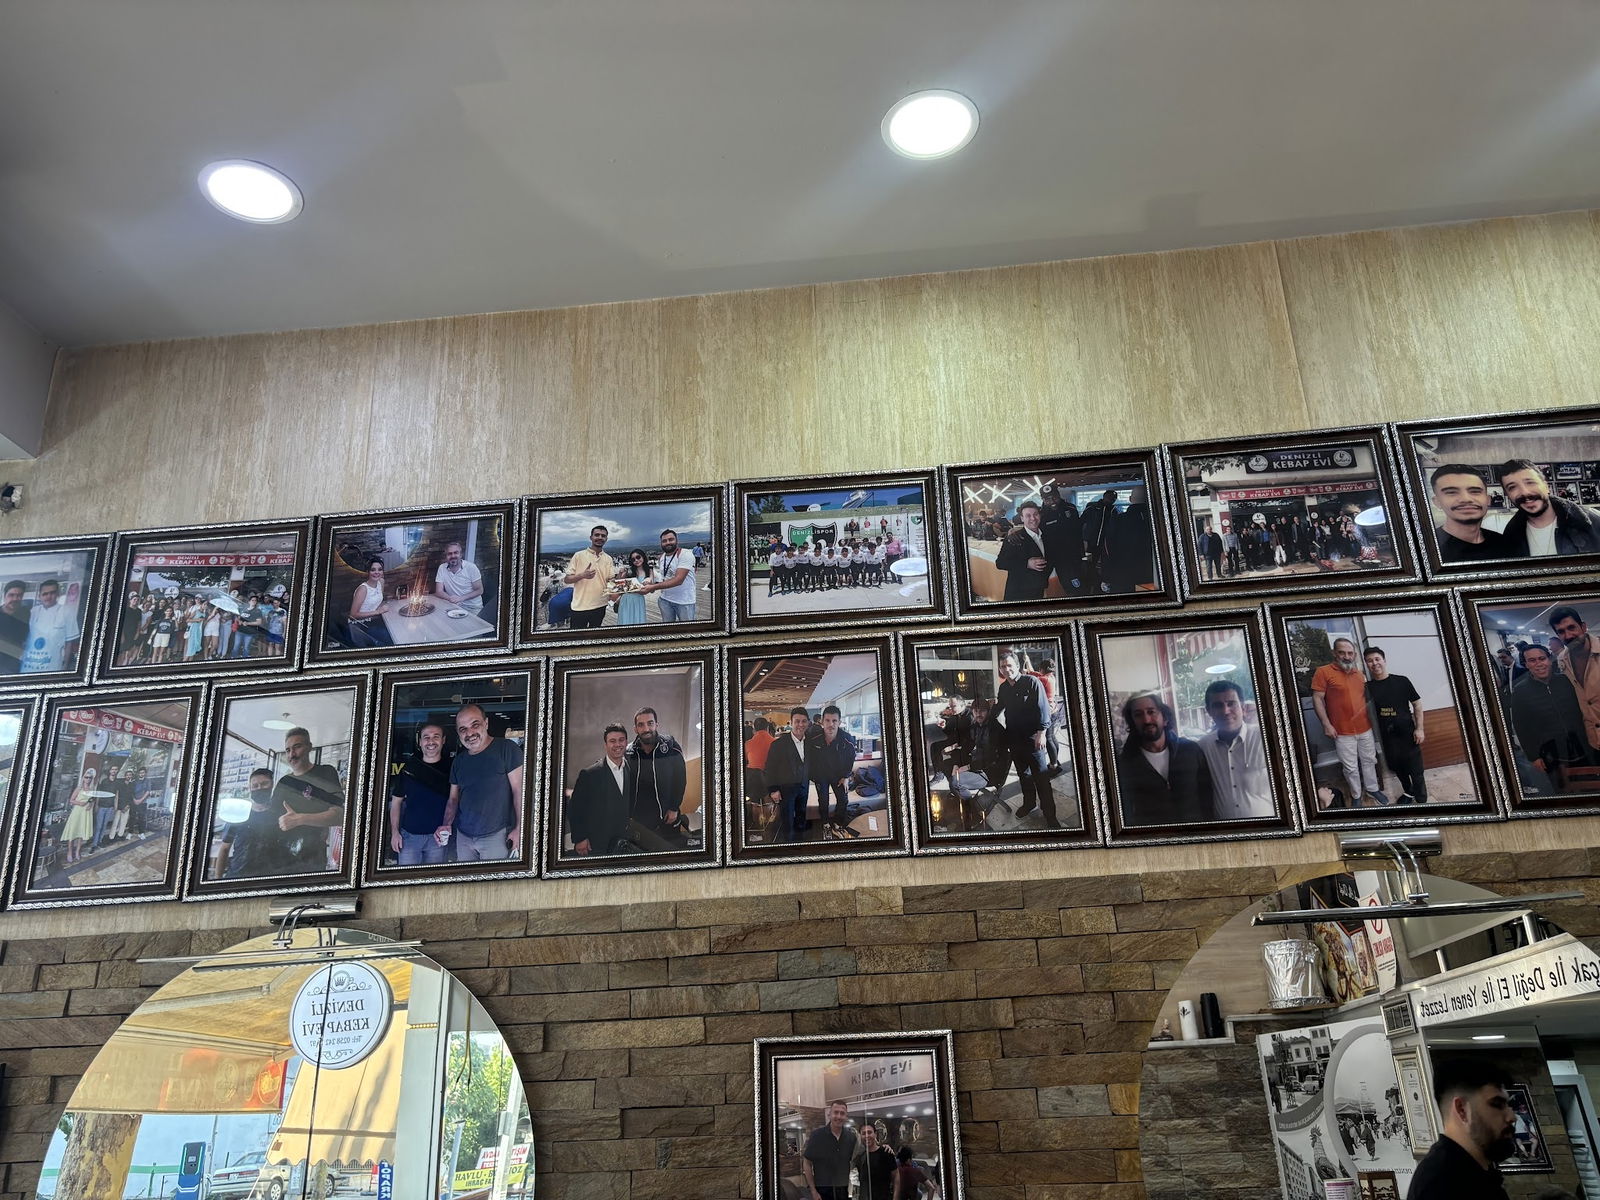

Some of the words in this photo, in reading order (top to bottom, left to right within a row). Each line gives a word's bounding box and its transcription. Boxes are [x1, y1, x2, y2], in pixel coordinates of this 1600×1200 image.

[1273, 460, 1310, 469] KEBAP
[1313, 457, 1331, 467] EVİ
[851, 1067, 886, 1085] KEBAP
[455, 1170, 482, 1181] HAVLU
